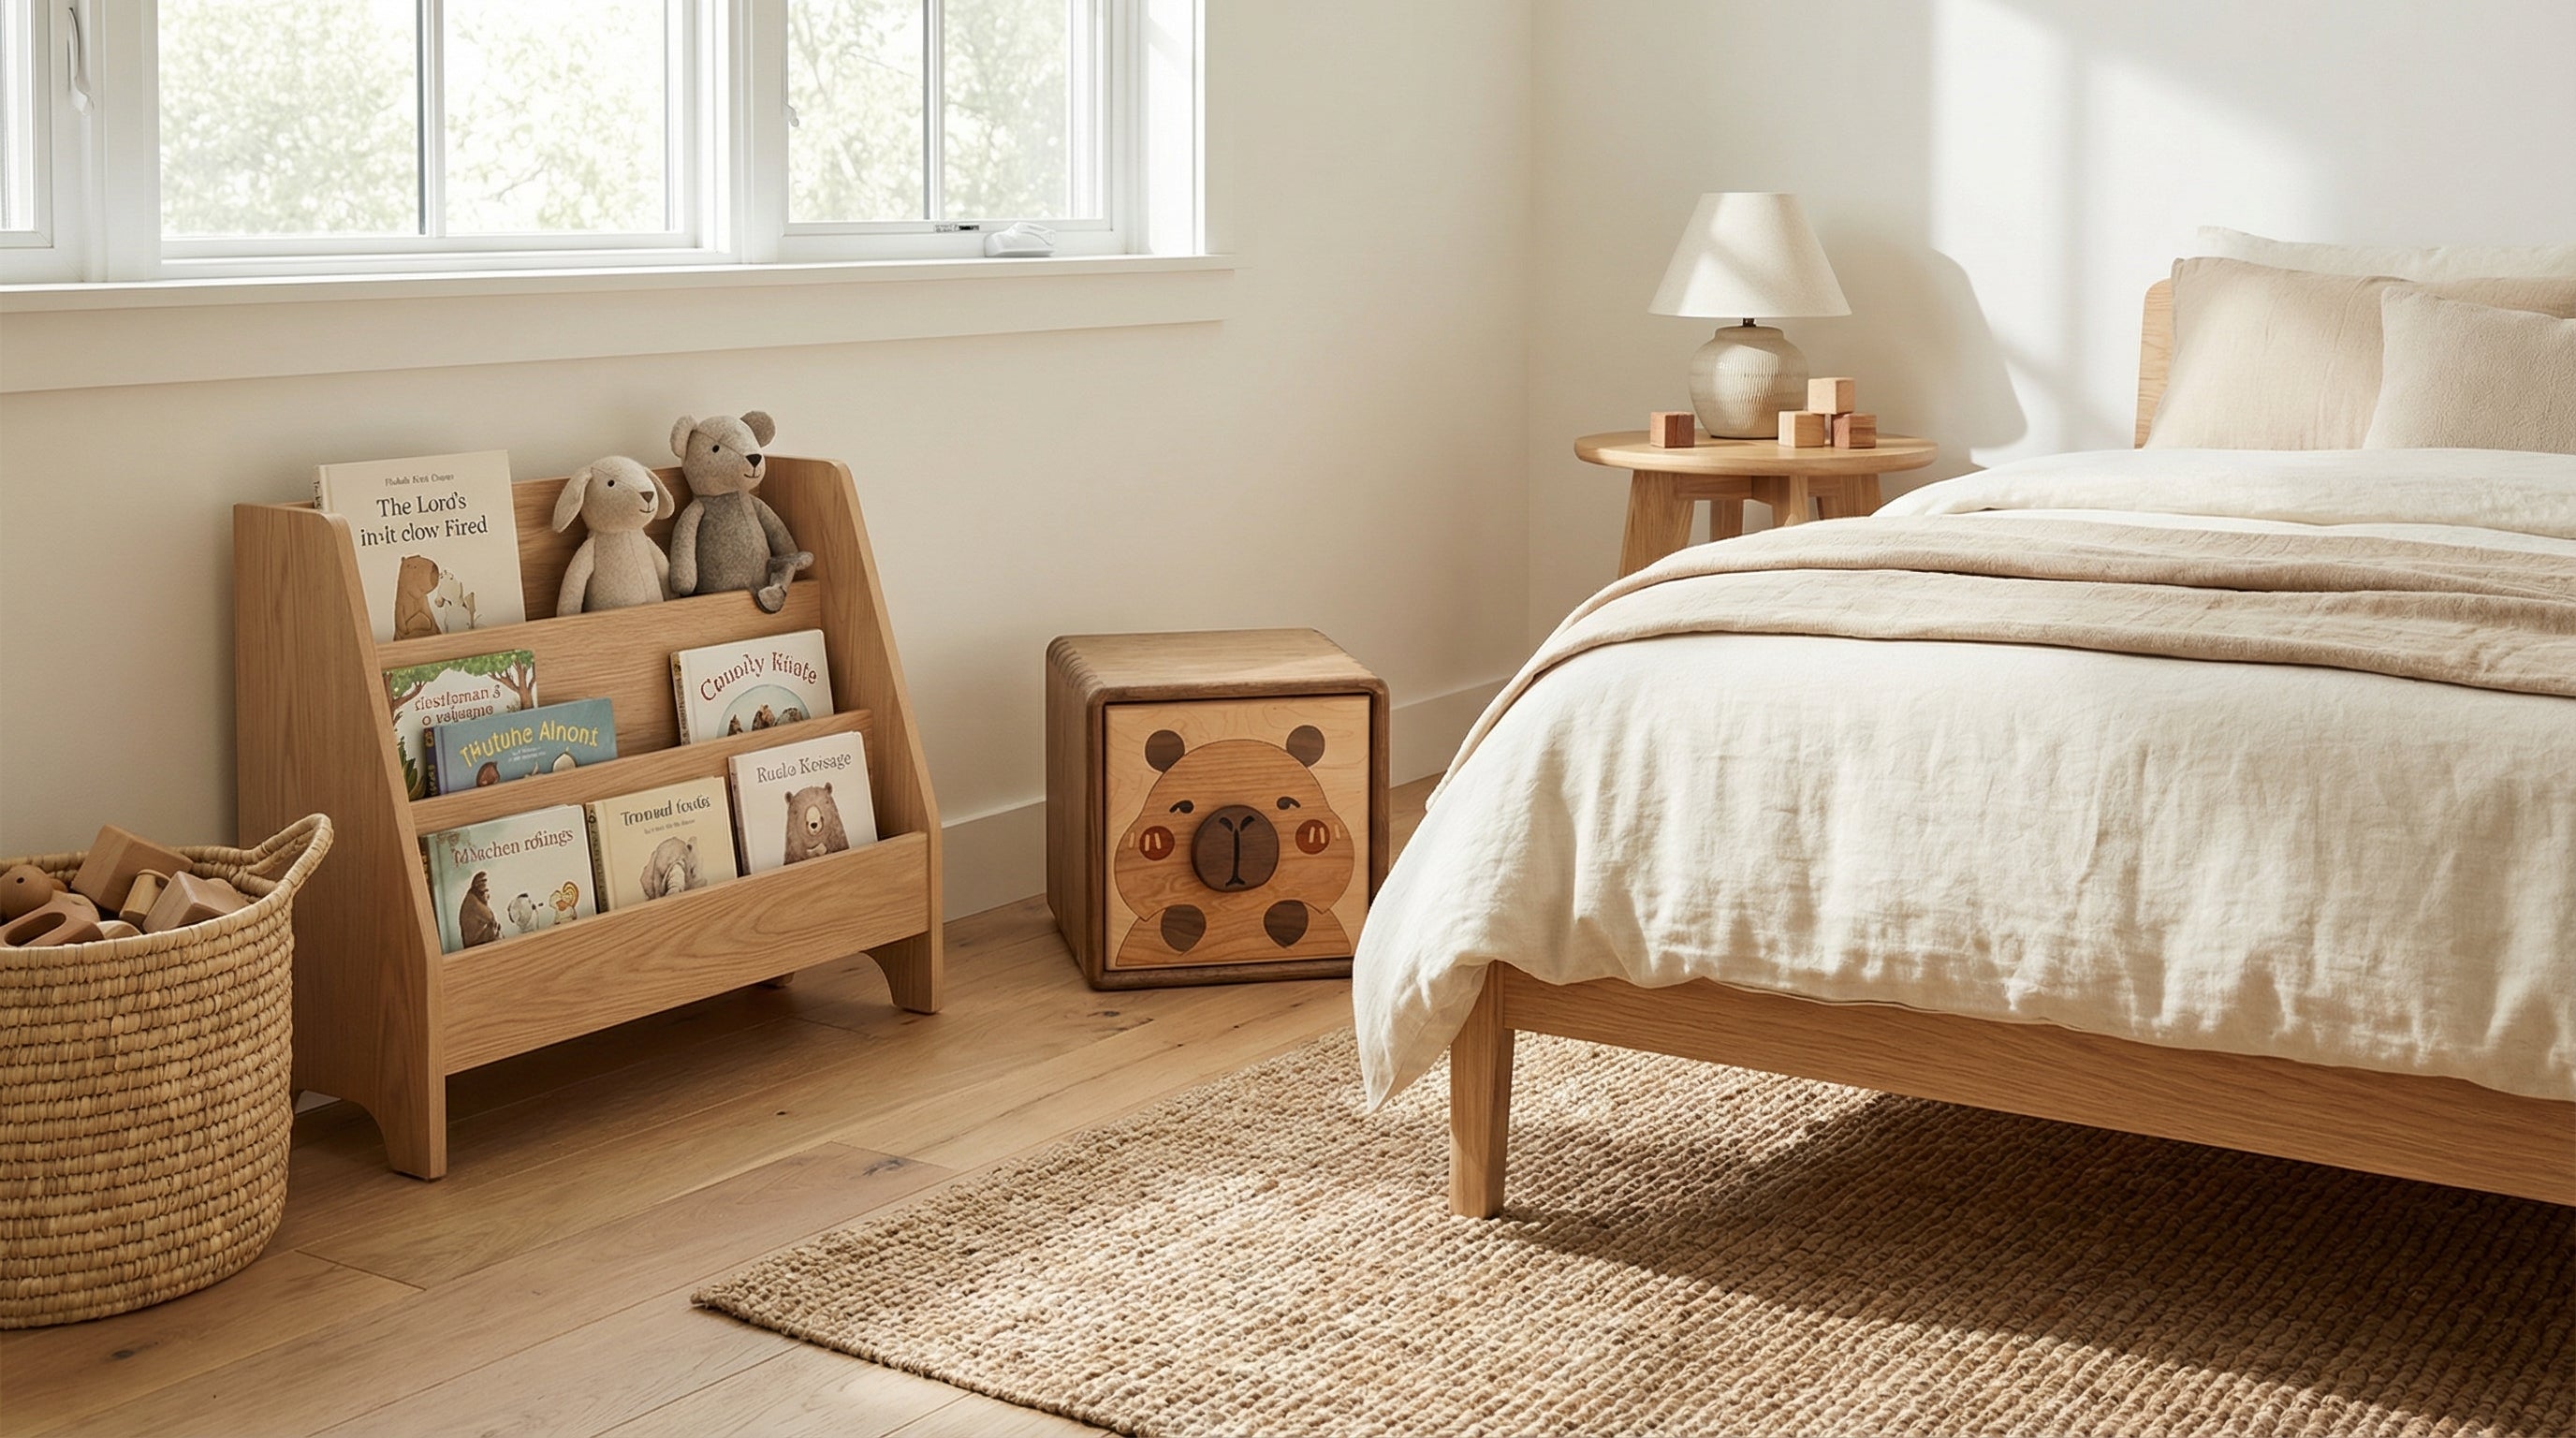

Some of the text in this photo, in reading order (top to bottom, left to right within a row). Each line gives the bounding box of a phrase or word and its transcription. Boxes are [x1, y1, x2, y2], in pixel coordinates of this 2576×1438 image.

[376, 492, 467, 518] The Lord's
[402, 522, 440, 542] clow
[445, 515, 488, 537] Fired
